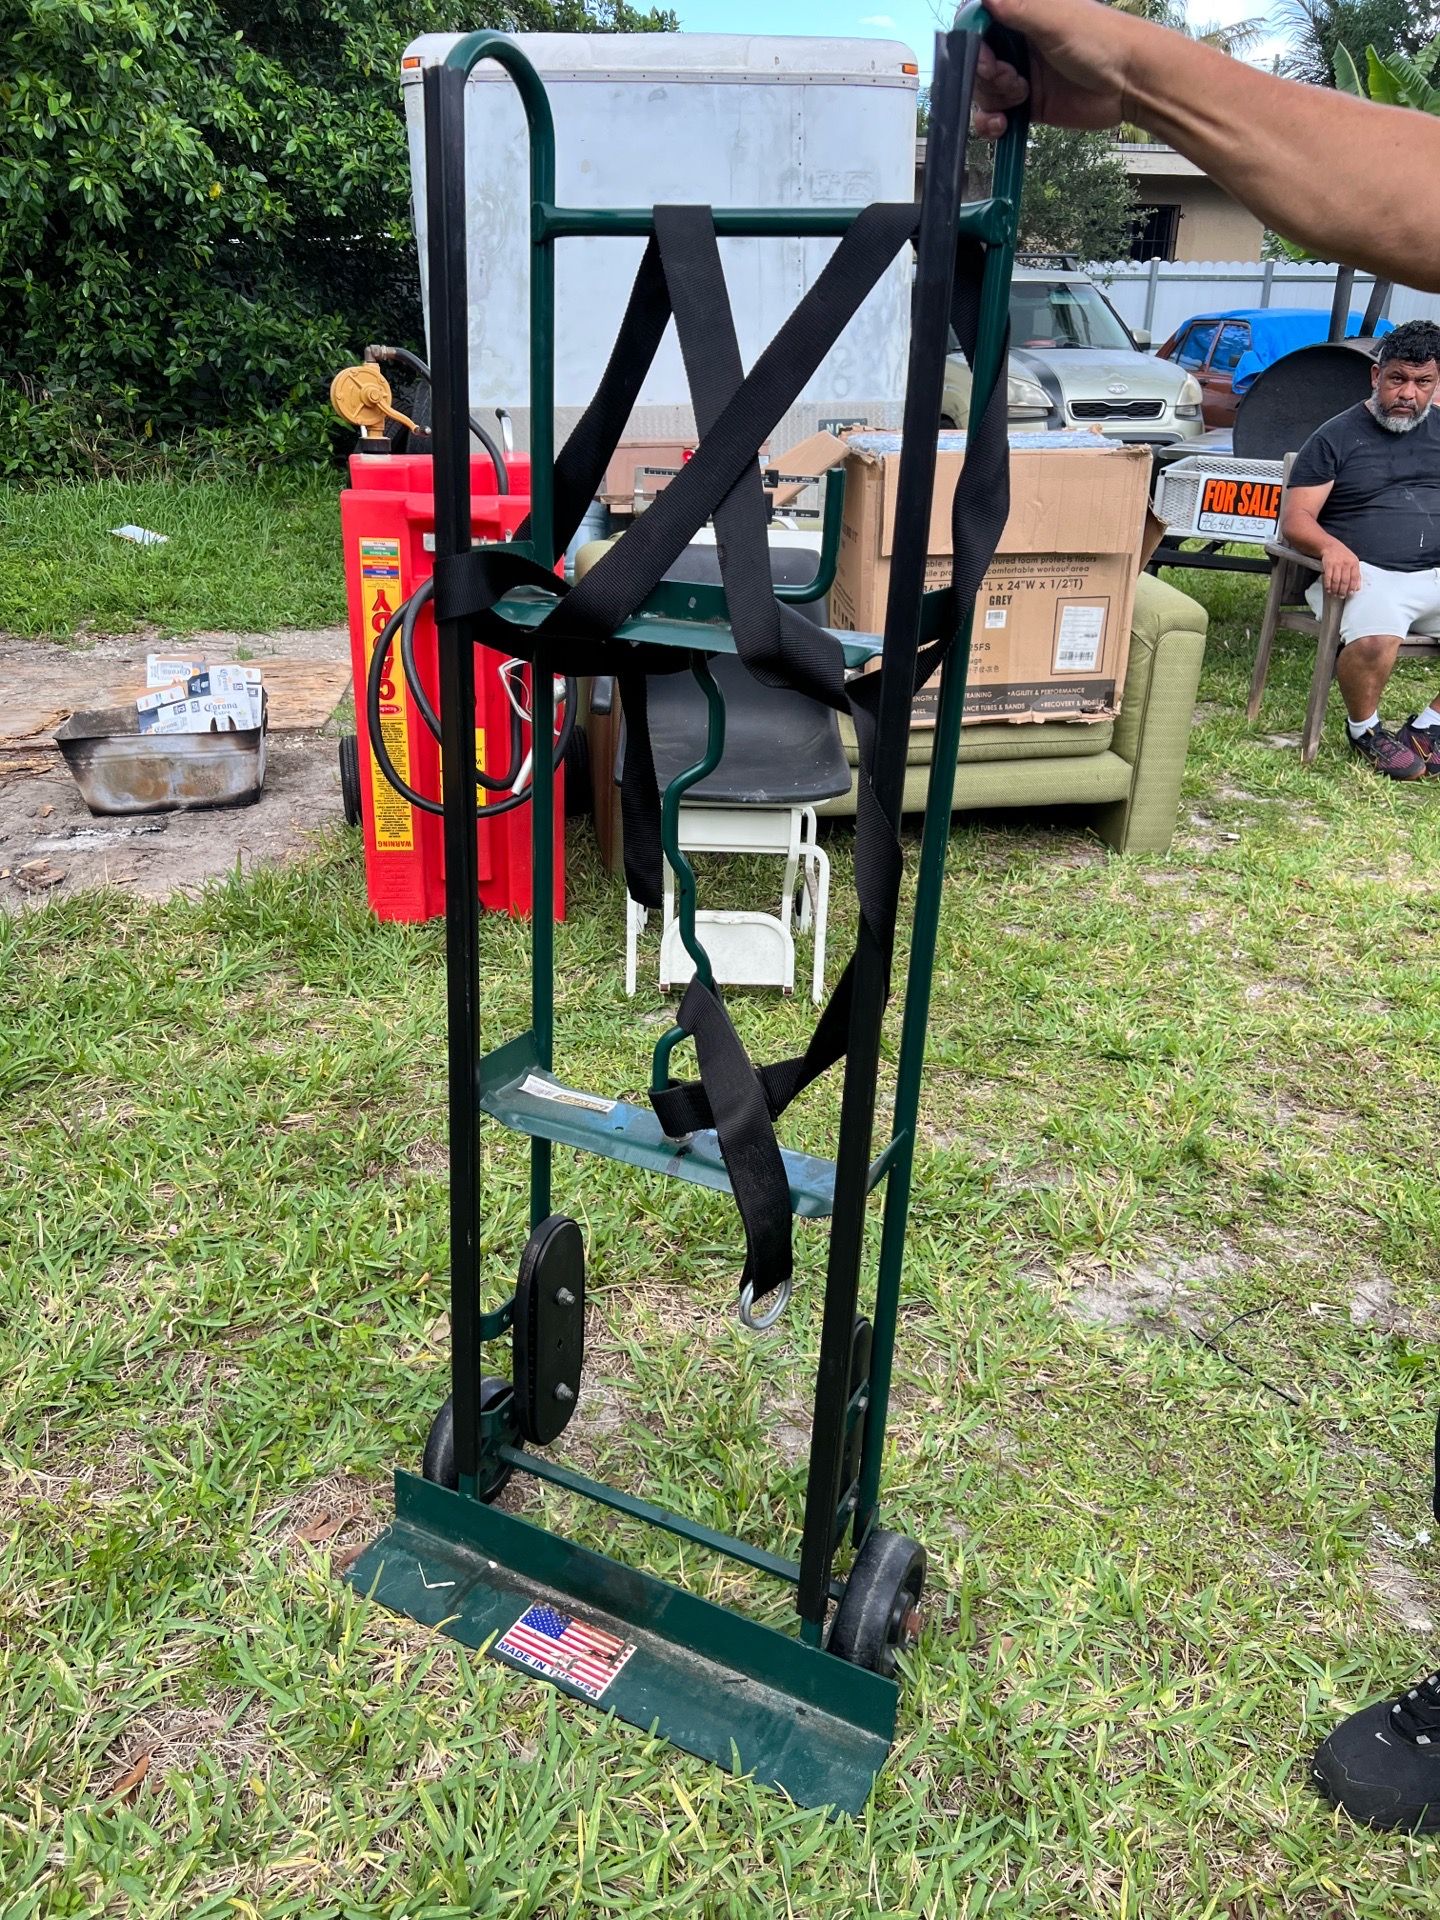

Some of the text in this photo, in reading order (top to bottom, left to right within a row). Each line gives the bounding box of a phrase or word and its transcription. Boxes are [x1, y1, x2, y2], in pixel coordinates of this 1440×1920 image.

[1203, 480, 1281, 518] FOR SALE
[1018, 555, 1038, 564] foam
[1075, 552, 1097, 563] floors
[987, 565, 1034, 575] comfortable
[1037, 564, 1069, 573] workout
[1070, 565, 1090, 573] area
[1039, 580, 1046, 590] x
[989, 594, 1013, 606] GREY
[1040, 687, 1086, 696] PERFORMANCE
[204, 702, 238, 712] Corona
[1004, 702, 1026, 710] BANDS
[1044, 700, 1075, 708] RECOVERY
[378, 840, 412, 848] WARNING
[497, 1641, 532, 1663] MADE
[532, 1660, 546, 1671] IN
